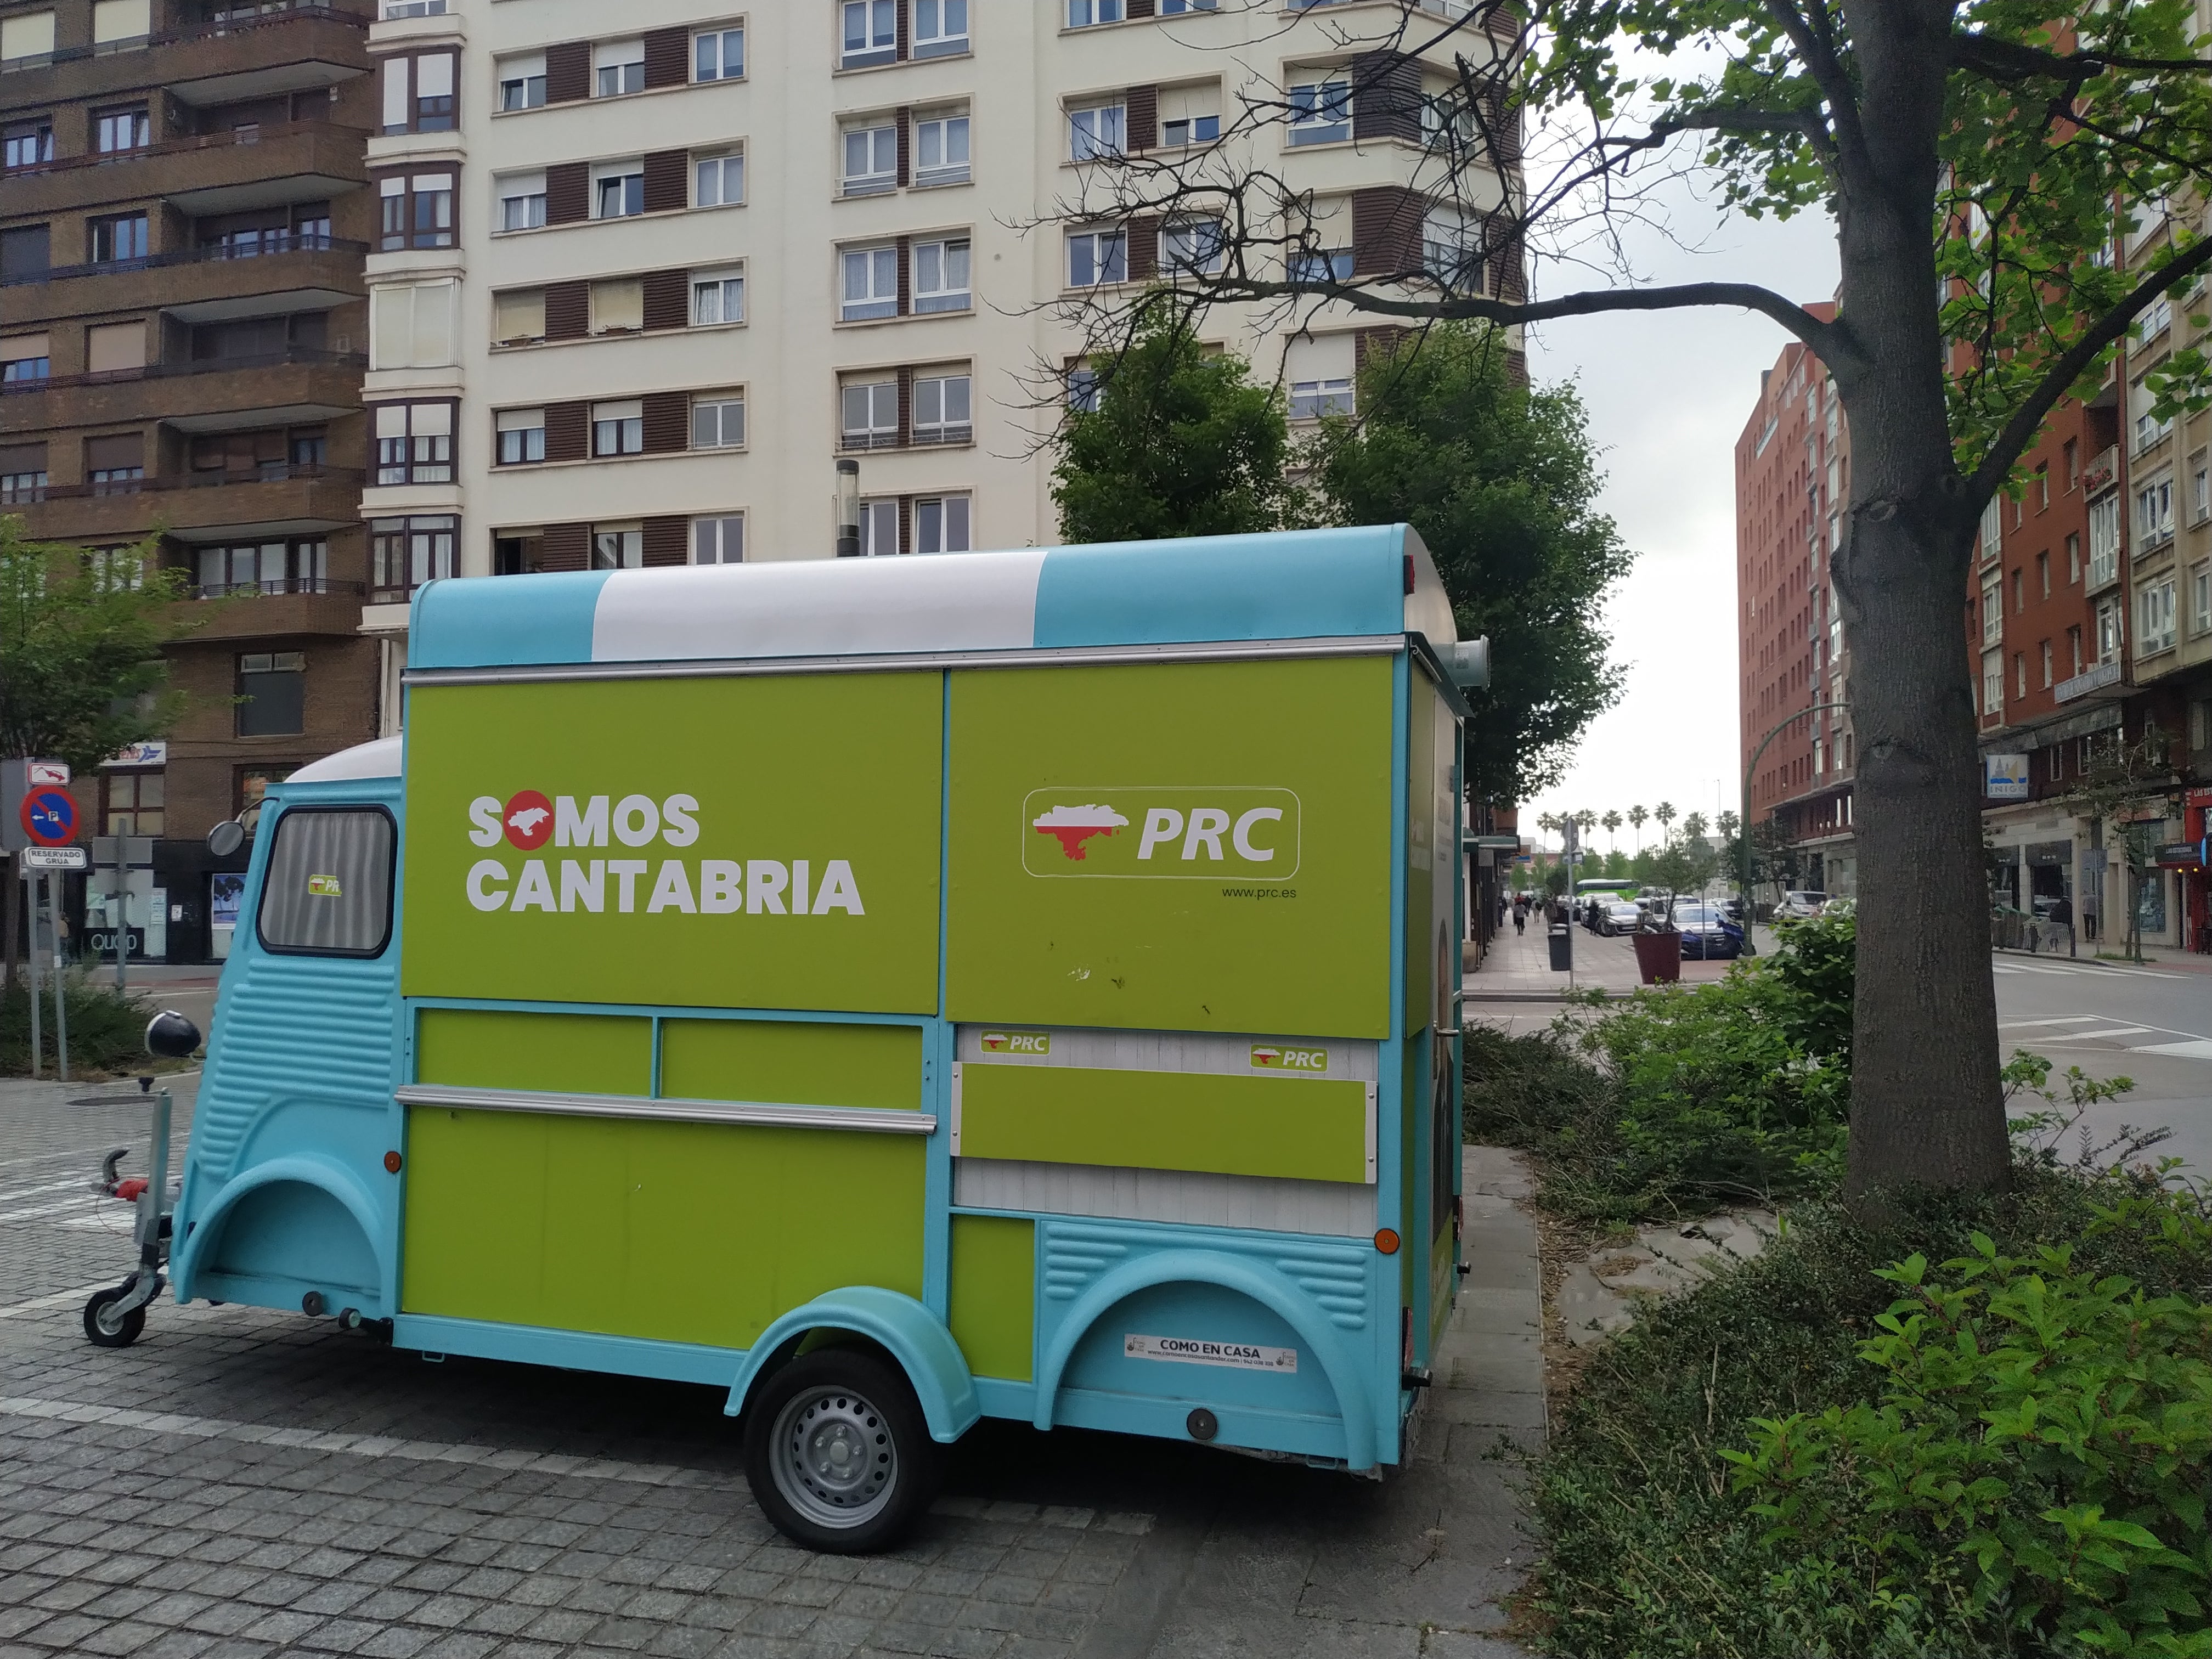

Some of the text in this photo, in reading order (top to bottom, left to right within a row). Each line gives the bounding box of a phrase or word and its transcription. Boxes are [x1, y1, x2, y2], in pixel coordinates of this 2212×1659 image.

[2194, 788, 2203, 797] LAS
[1137, 808, 1283, 861] PRC
[466, 859, 865, 915] CANTABRIA
[1222, 889, 1296, 900] www.prc.es
[1010, 1036, 1046, 1051] PRC
[1283, 1051, 1324, 1068] PRC
[1160, 1339, 1260, 1358] COMO EN CASA
